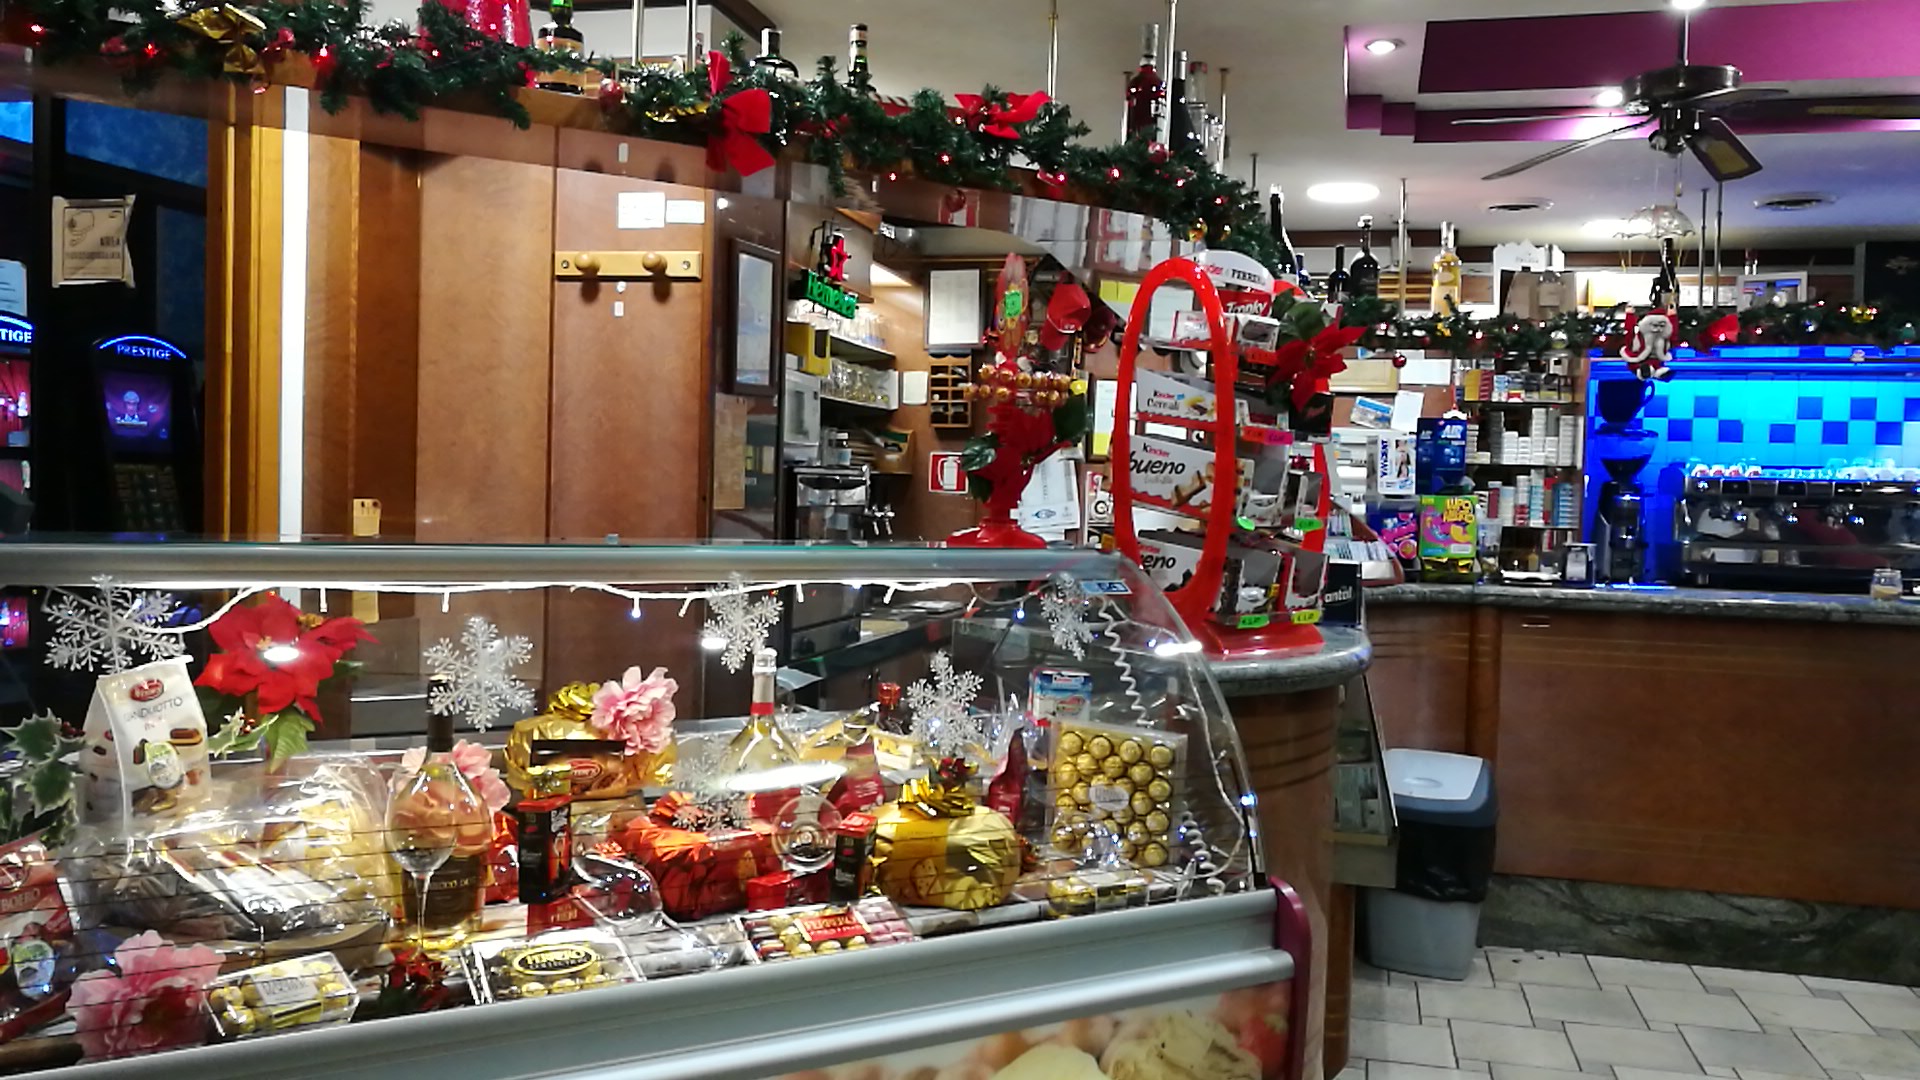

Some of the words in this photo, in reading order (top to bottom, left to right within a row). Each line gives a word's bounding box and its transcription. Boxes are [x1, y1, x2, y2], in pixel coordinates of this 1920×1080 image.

[1226, 300, 1268, 315] Tronky
[116, 344, 172, 361] PRESTIGE
[1129, 450, 1186, 475] bueno
[525, 948, 586, 965] FERRERO
